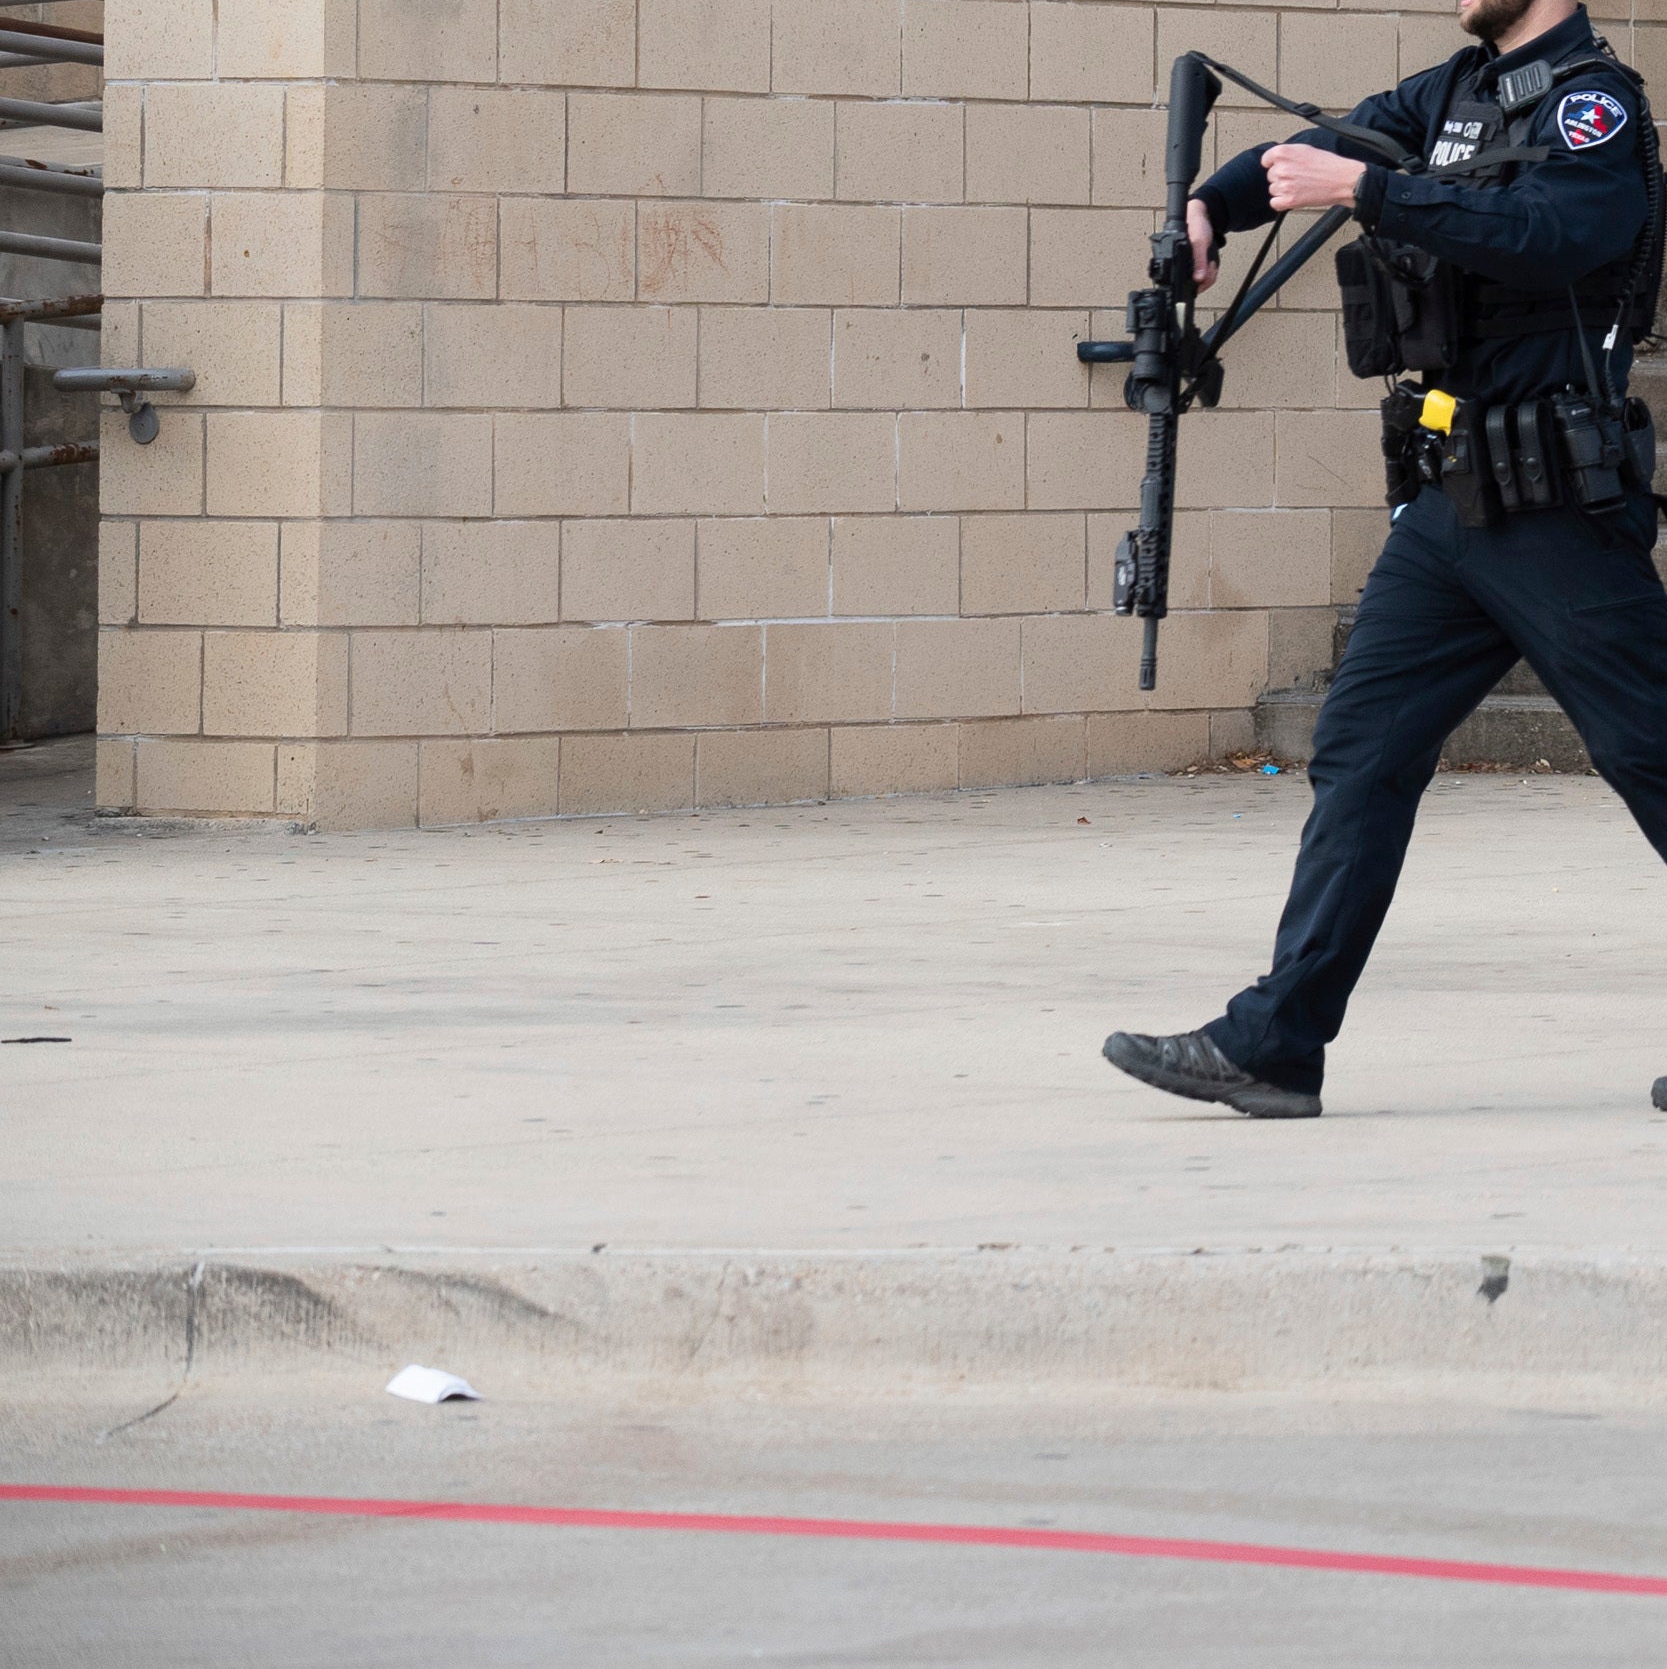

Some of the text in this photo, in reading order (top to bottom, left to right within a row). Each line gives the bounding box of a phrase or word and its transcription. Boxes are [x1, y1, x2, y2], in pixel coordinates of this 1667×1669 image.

[1570, 93, 1622, 117] POLICE
[1564, 118, 1603, 138] ARLINGTON
[1429, 140, 1476, 167] POLICE
